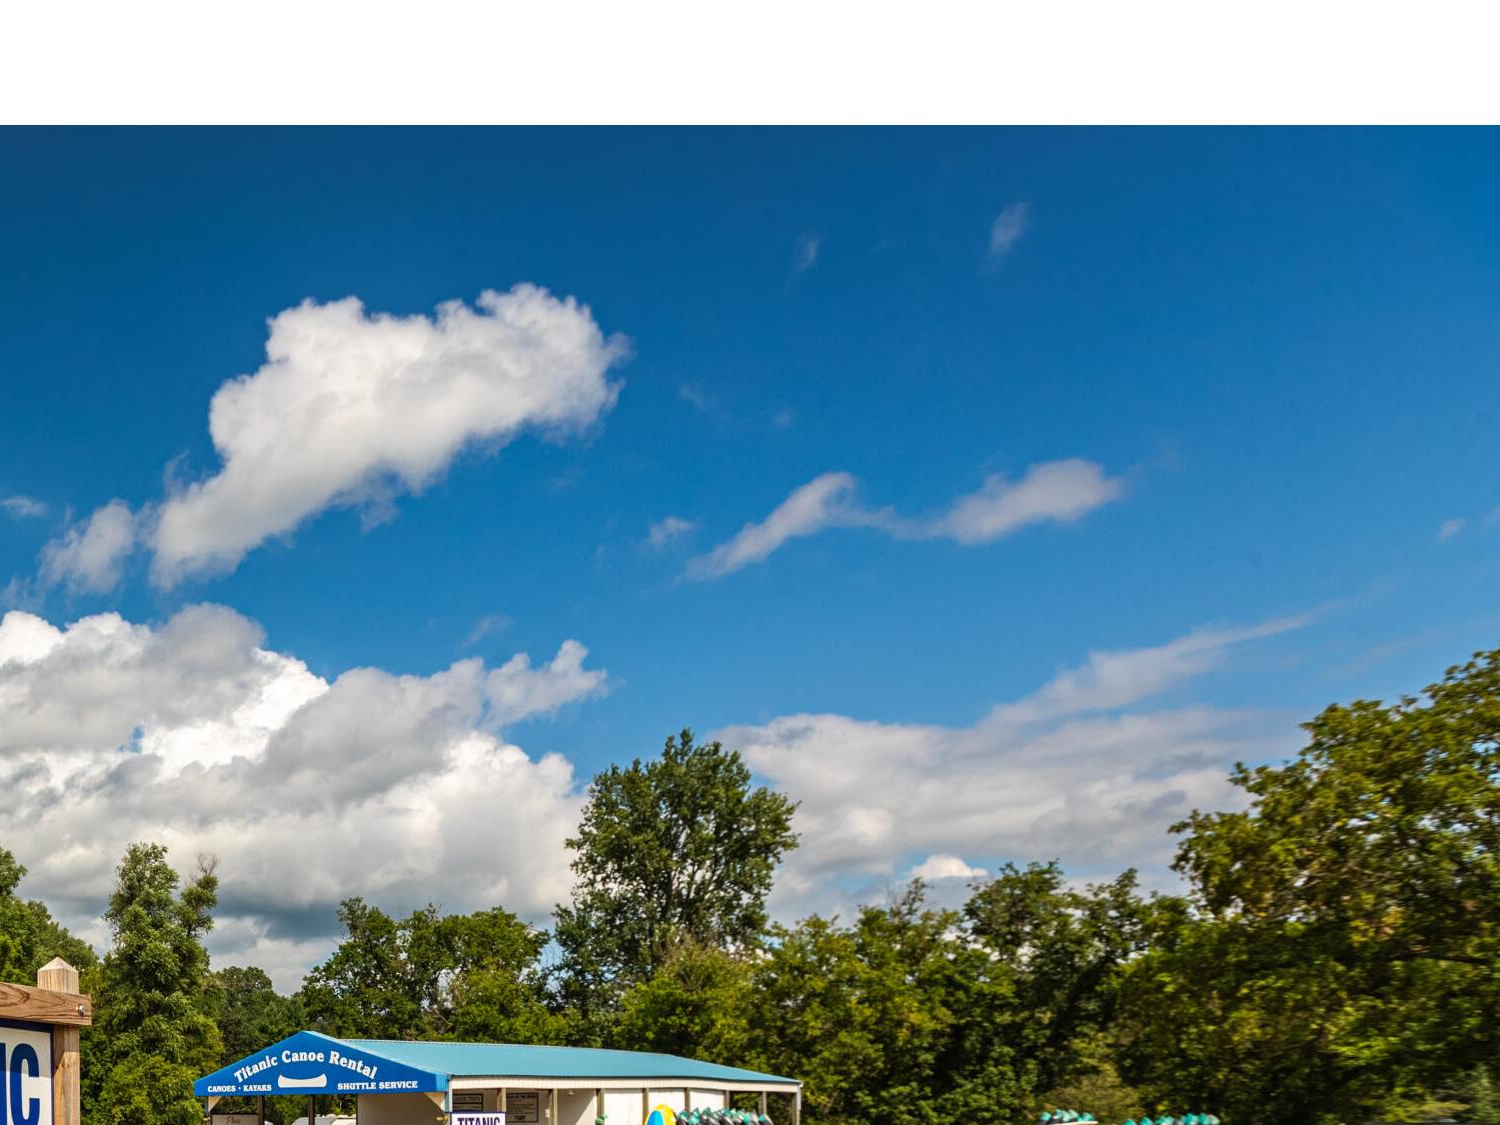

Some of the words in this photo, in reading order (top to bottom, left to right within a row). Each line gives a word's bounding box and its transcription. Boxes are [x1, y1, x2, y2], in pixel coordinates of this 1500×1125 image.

[234, 1054, 278, 1083] Titanic
[281, 1050, 325, 1063] Canoe
[328, 1051, 378, 1080] Rental
[207, 1085, 236, 1093] CANOES
[243, 1084, 272, 1092] KAYAKS
[337, 1082, 377, 1090] SHUTTLE
[378, 1081, 418, 1089] SERVICE
